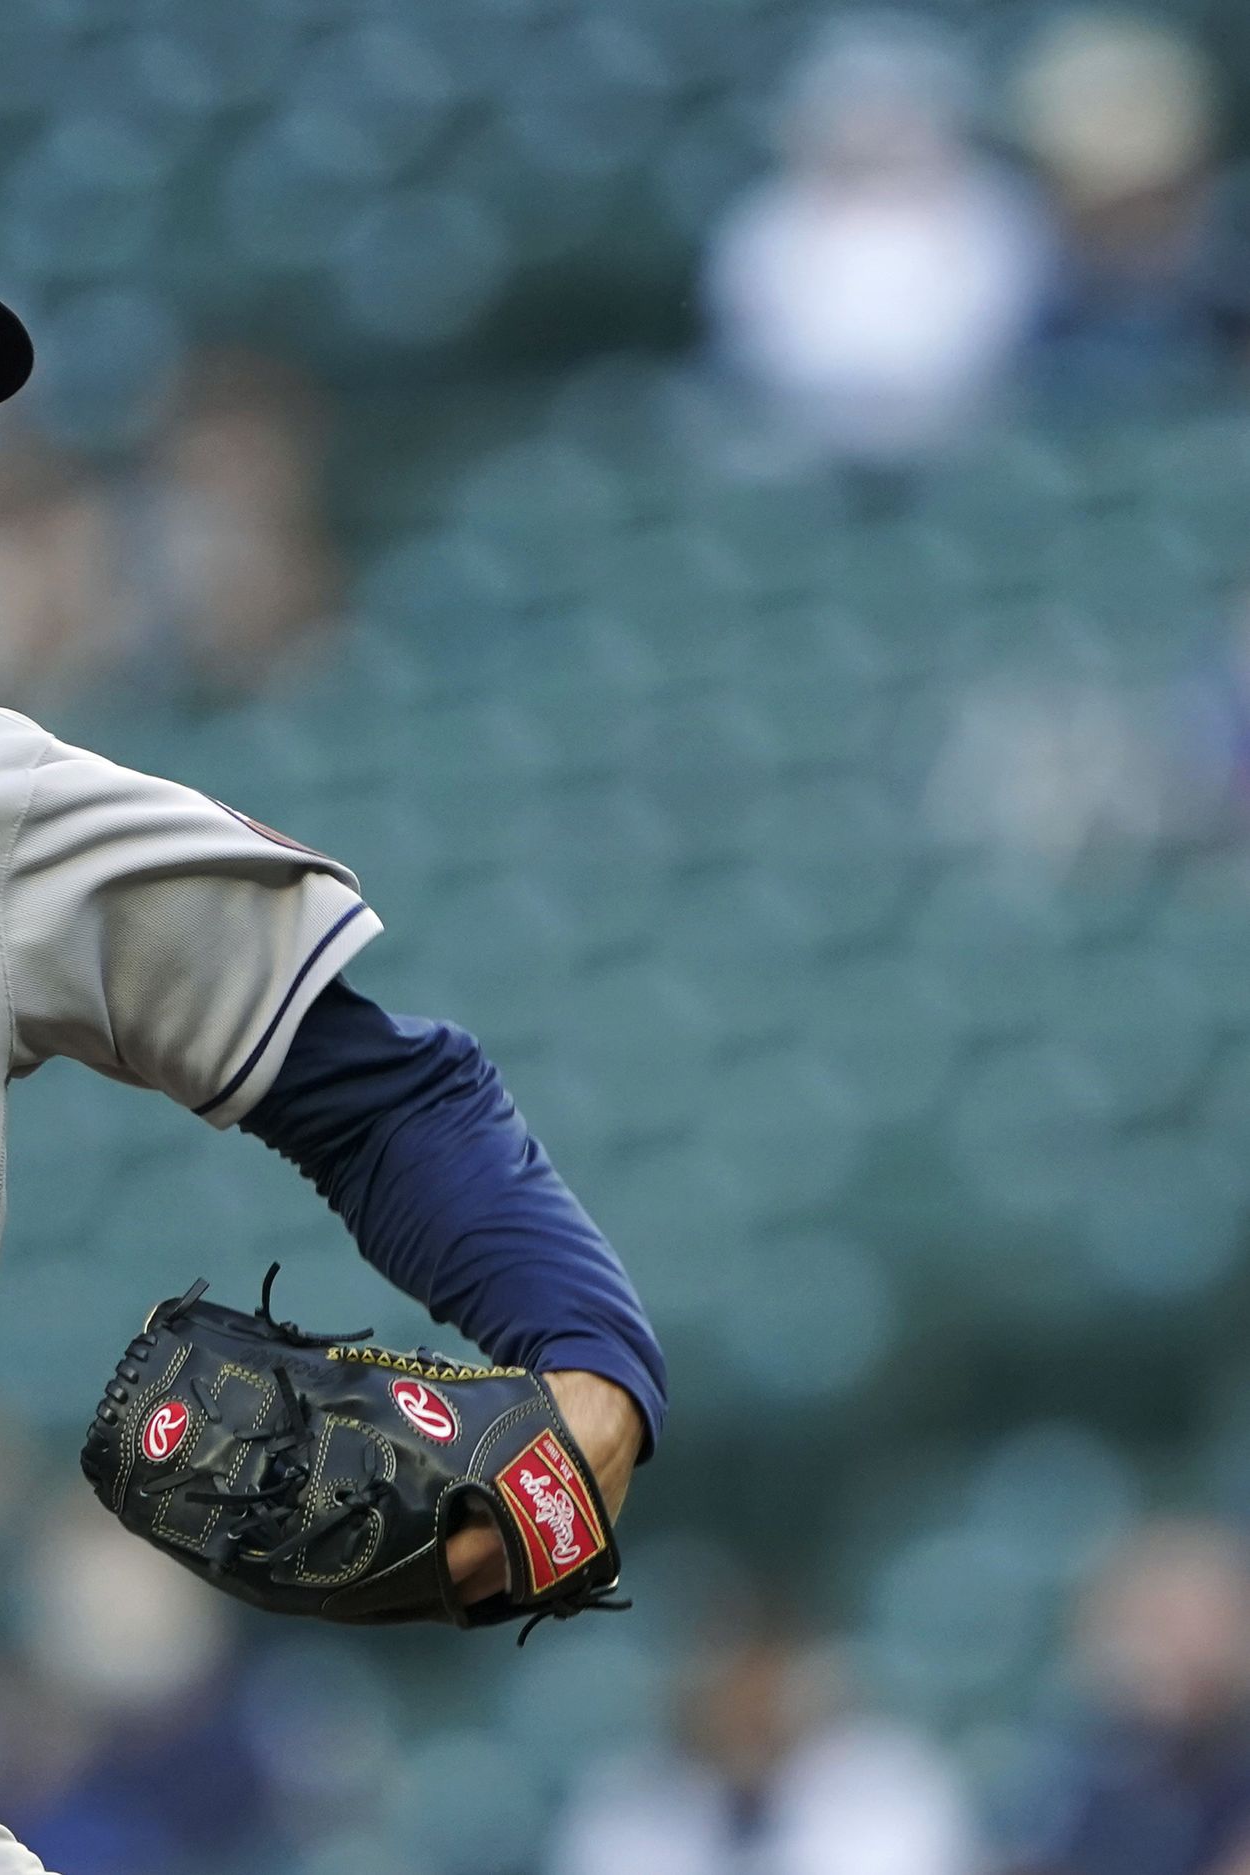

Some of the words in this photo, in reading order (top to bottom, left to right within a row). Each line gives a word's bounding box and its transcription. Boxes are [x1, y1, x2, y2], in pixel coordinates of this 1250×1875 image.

[149, 1407, 186, 1457] R
[397, 1383, 452, 1438] R
[519, 1468, 581, 1565] Rawlings
